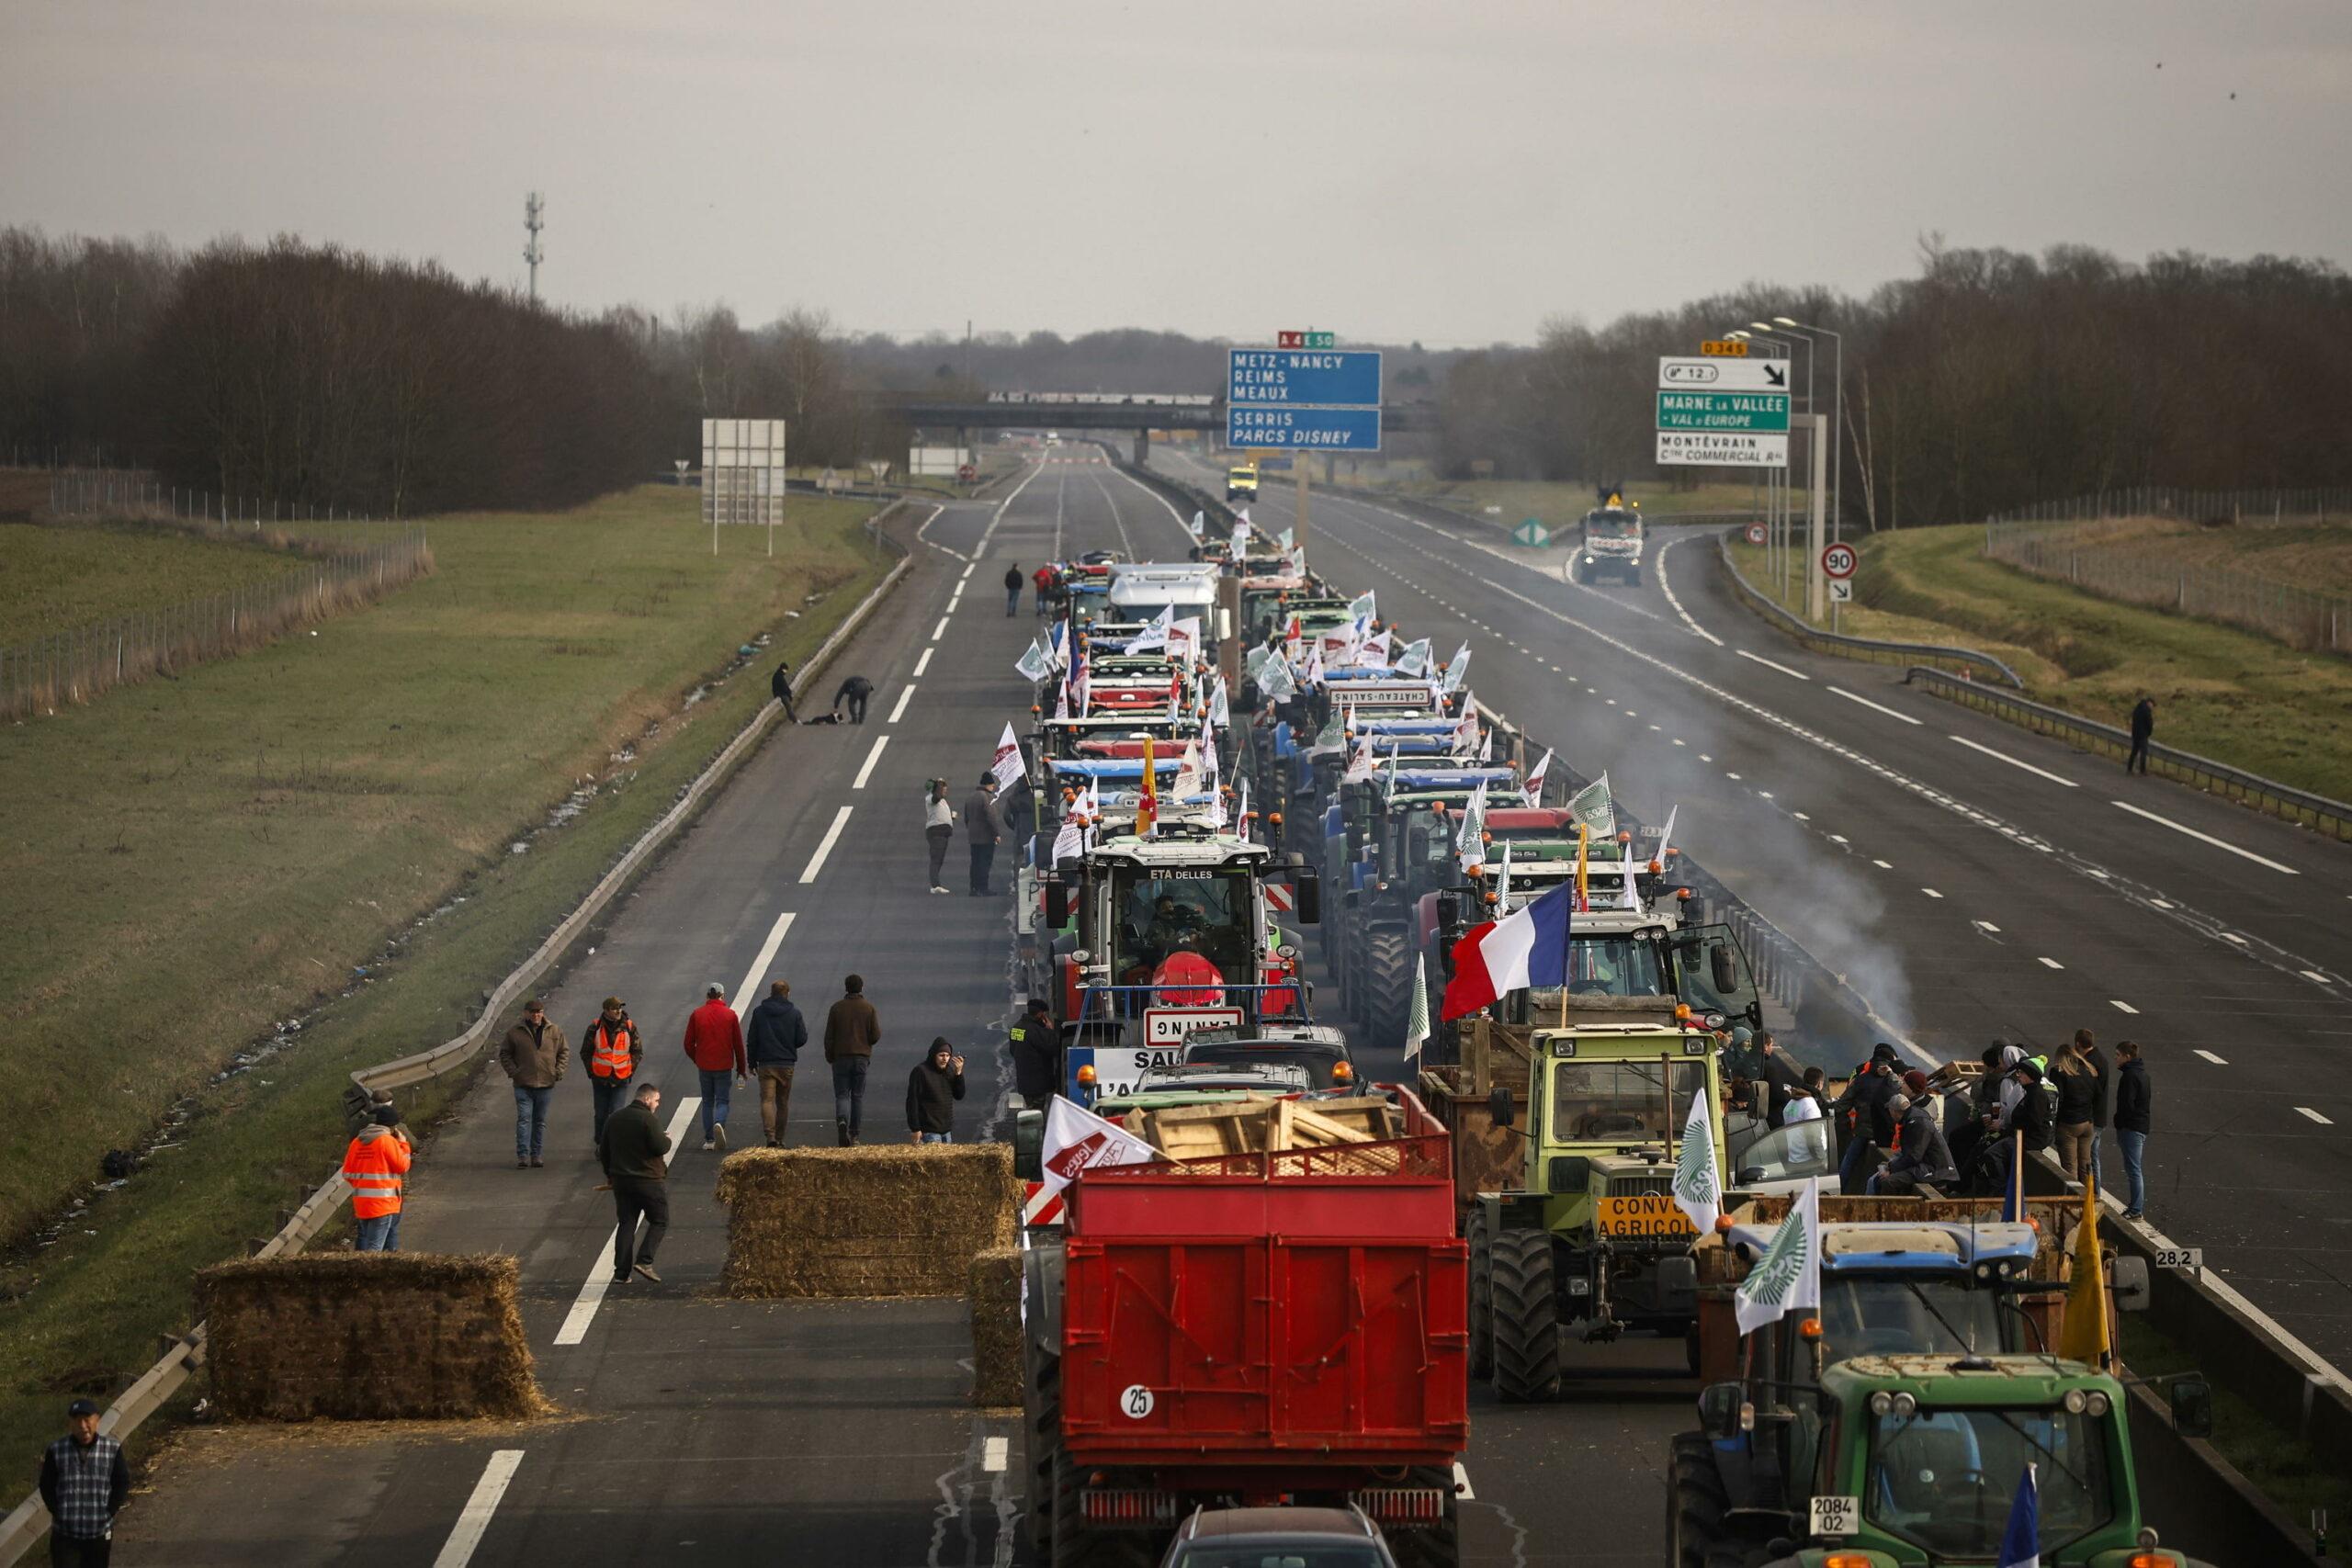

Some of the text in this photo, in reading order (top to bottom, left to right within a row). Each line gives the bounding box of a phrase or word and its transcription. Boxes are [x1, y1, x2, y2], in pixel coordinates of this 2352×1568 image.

[1281, 333, 1302, 346] A 4
[1235, 354, 1277, 367] METZ
[1290, 355, 1343, 369] NANCY
[1235, 369, 1285, 384] REIMS
[1234, 386, 1288, 400] MEAUX
[1663, 397, 1713, 411] MARNE
[1732, 395, 1783, 412] VALLÉE
[1234, 412, 1294, 426] SERRIS
[1671, 413, 1692, 425] VAL
[1234, 429, 1351, 445] PARCS DISNEY
[1662, 435, 1757, 448] MONTÉVRAIN
[1686, 450, 1762, 462] COMMERCIAL
[1828, 553, 1849, 569] 90
[1150, 869, 1213, 880] ETA DELLES
[2156, 1251, 2191, 1267] 28,2
[1130, 1388, 1147, 1414] 25
[1815, 1498, 1852, 1515] 2084
[1823, 1515, 1843, 1531] 02
